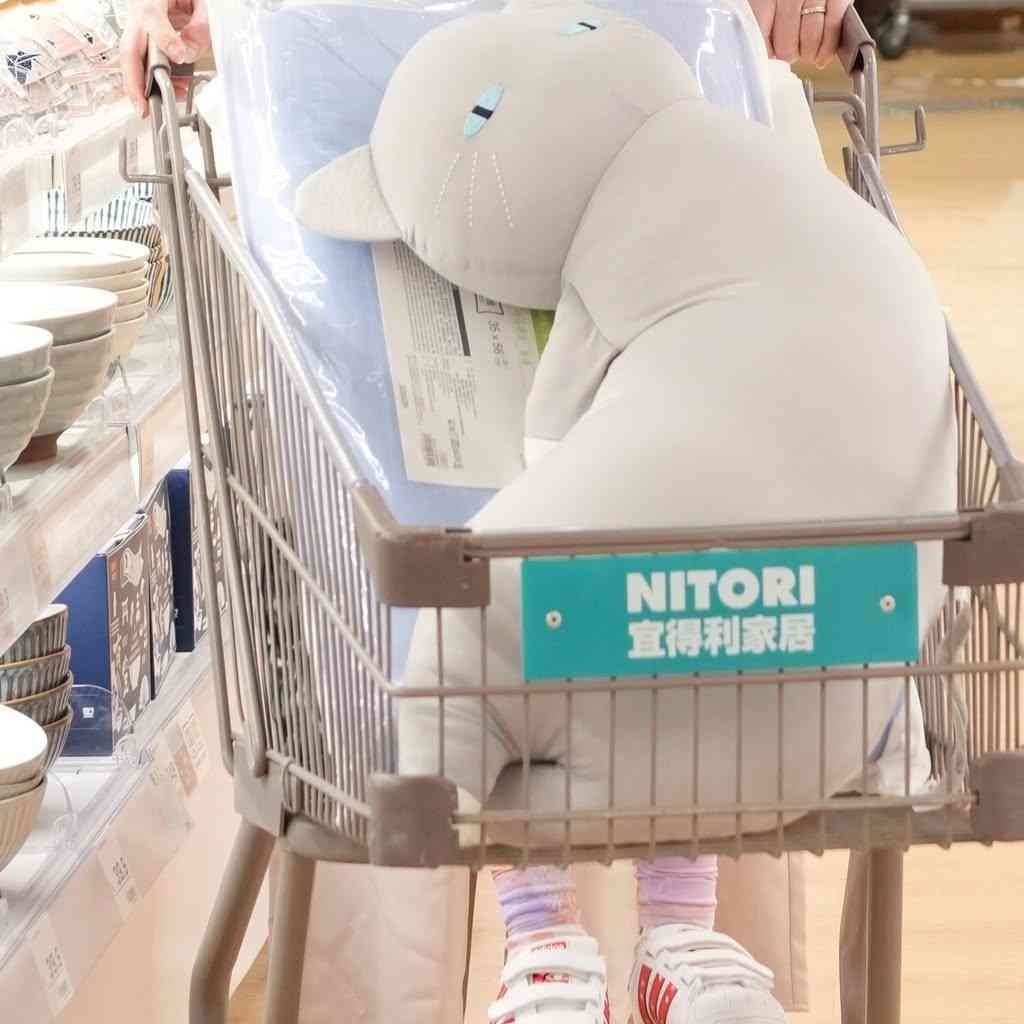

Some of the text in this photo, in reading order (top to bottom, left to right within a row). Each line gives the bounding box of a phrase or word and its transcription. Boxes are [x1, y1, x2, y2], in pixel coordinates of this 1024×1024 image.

[627, 565, 815, 613] NITORI
[628, 613, 816, 659] 宜得利家居
